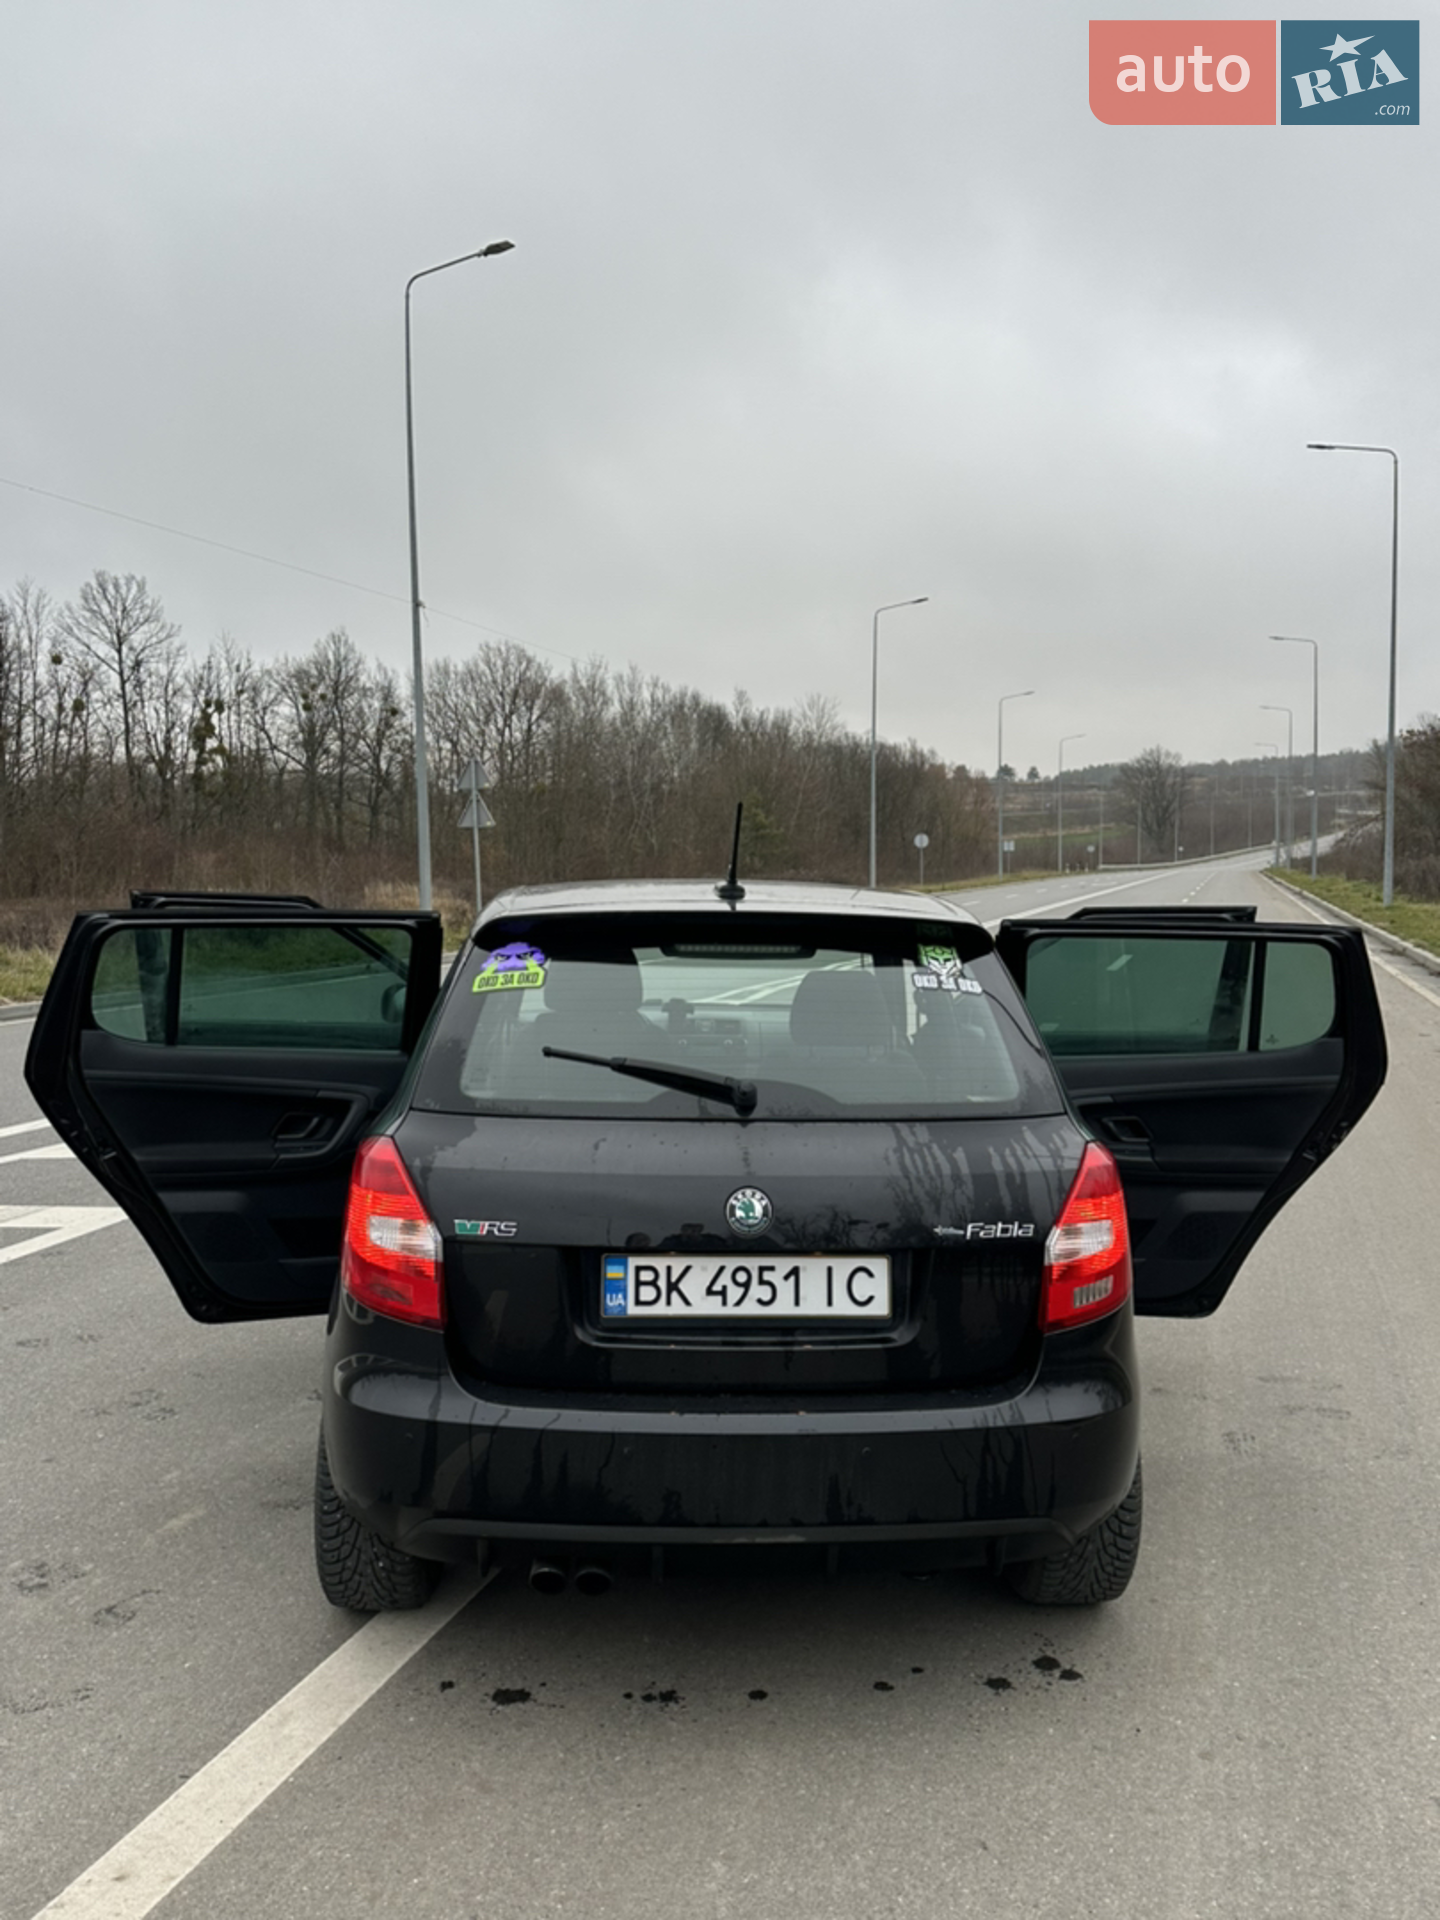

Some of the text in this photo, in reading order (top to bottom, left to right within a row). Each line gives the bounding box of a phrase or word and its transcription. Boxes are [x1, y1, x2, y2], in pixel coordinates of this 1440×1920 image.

[605, 1293, 626, 1306] UA
[633, 1264, 876, 1307] BK 4951 IC
